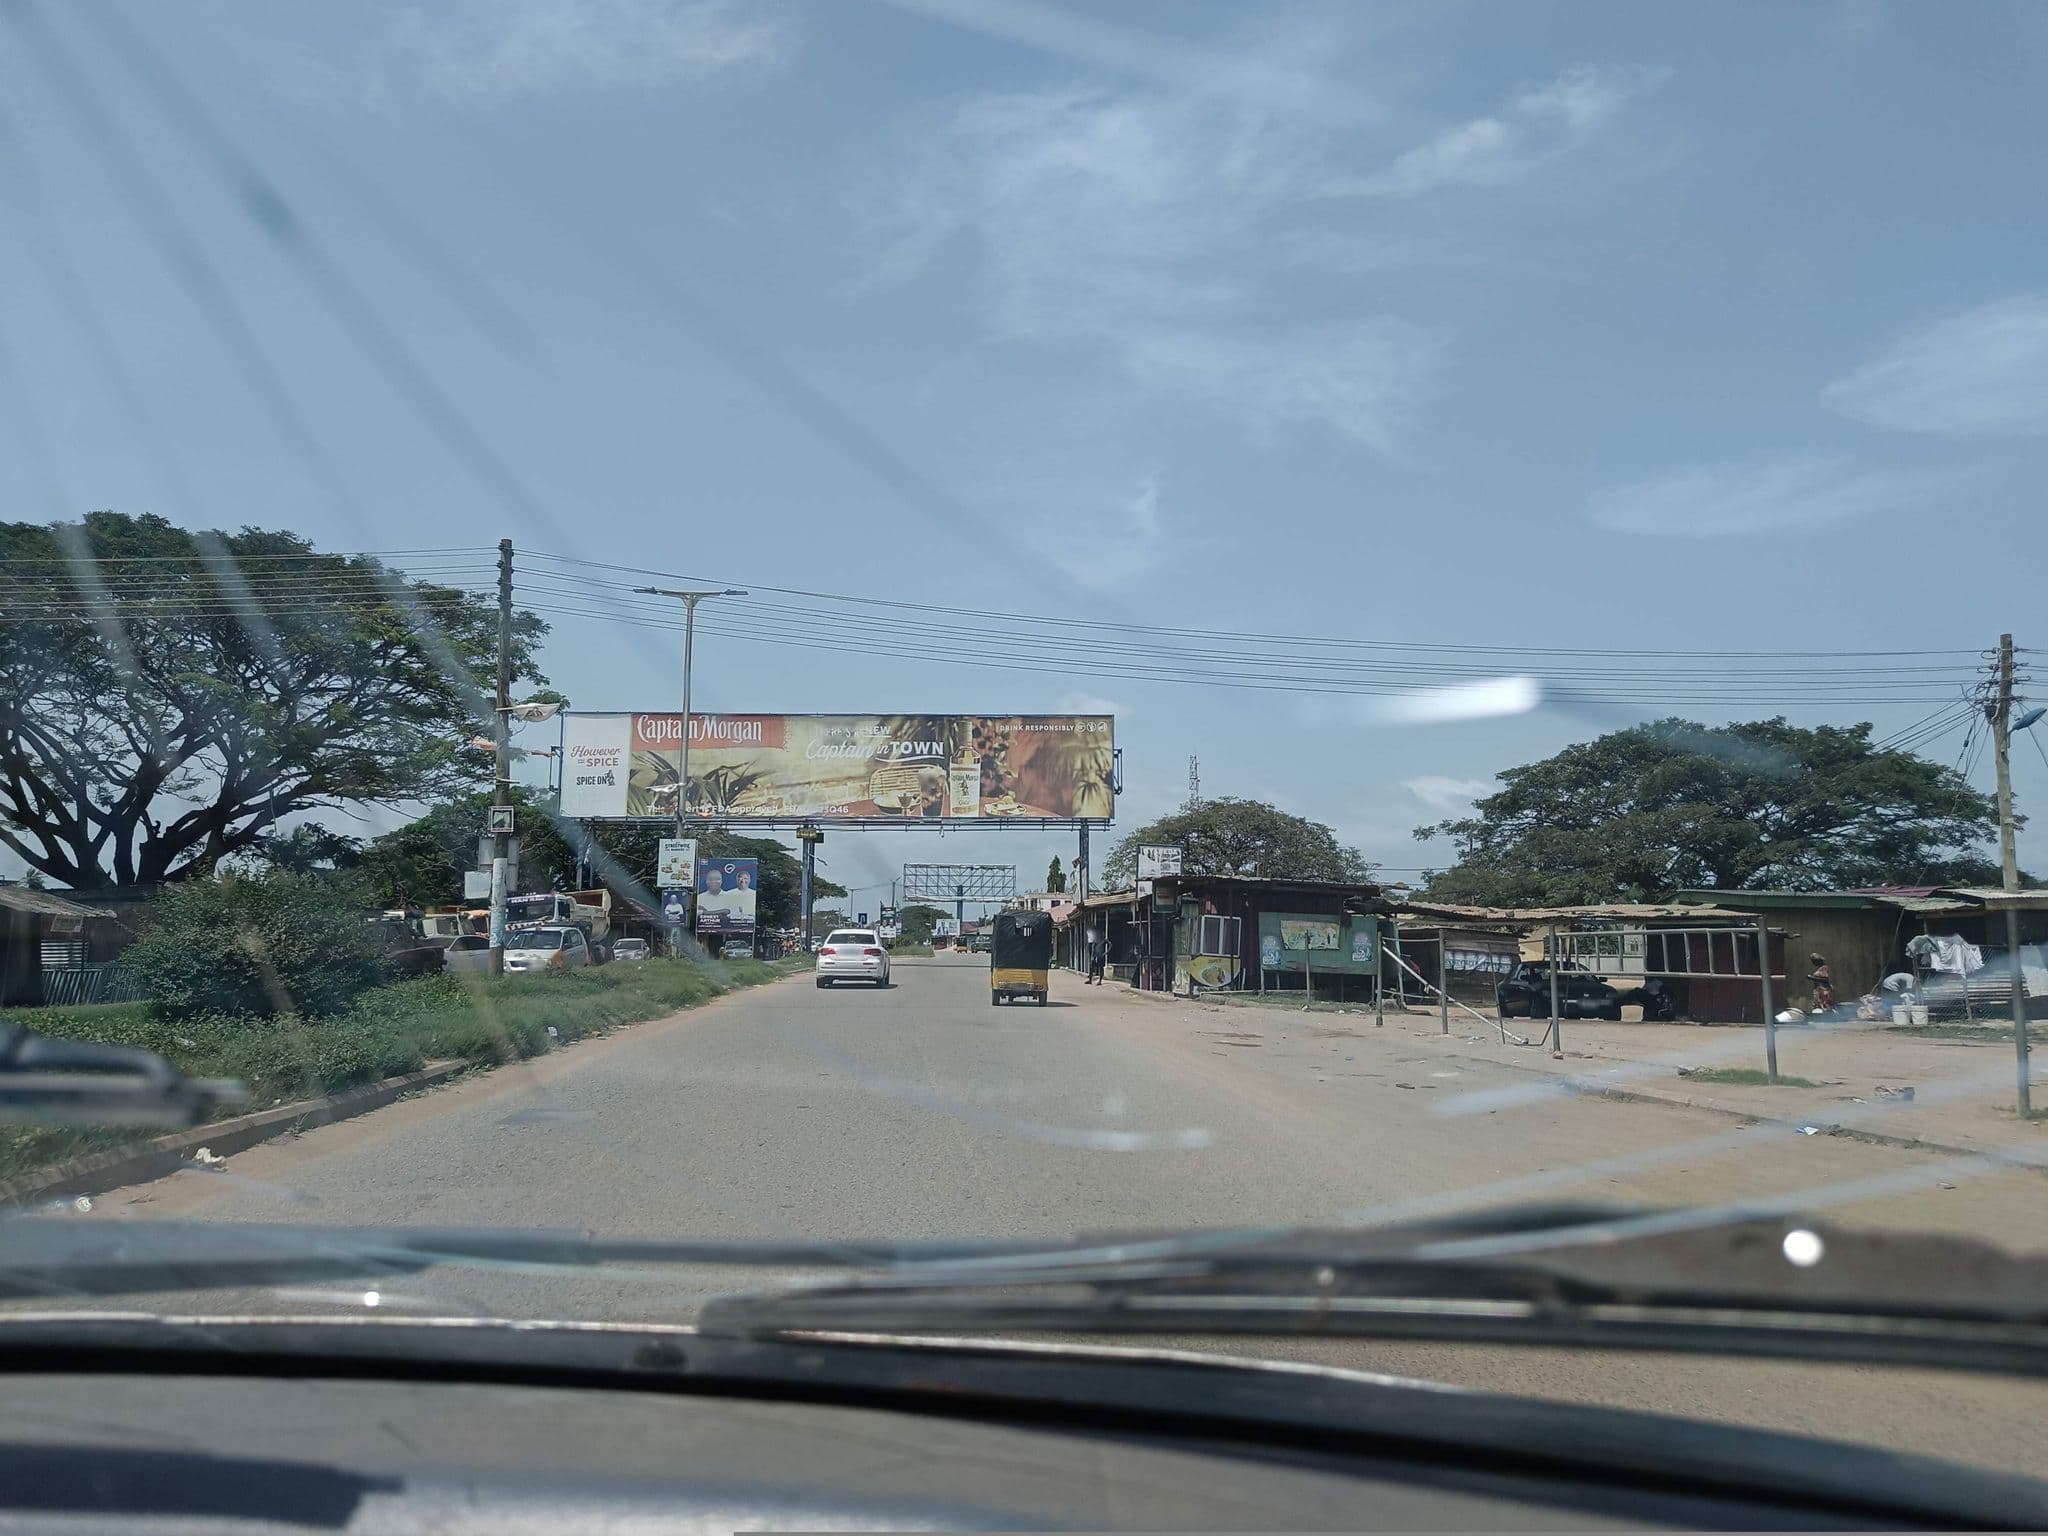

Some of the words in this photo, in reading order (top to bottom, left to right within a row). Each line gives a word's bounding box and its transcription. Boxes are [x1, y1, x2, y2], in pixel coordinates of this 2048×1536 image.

[637, 715, 697, 743] Captan
[699, 715, 762, 743] Morgan
[1025, 724, 1075, 732] RESPONSIBLY
[570, 745, 621, 758] However
[805, 739, 874, 761] Captain
[890, 741, 944, 755] TOWN
[586, 757, 620, 767] SPICE
[576, 776, 597, 786] SPICE
[597, 775, 608, 785] ON
[711, 804, 731, 813] FDA
